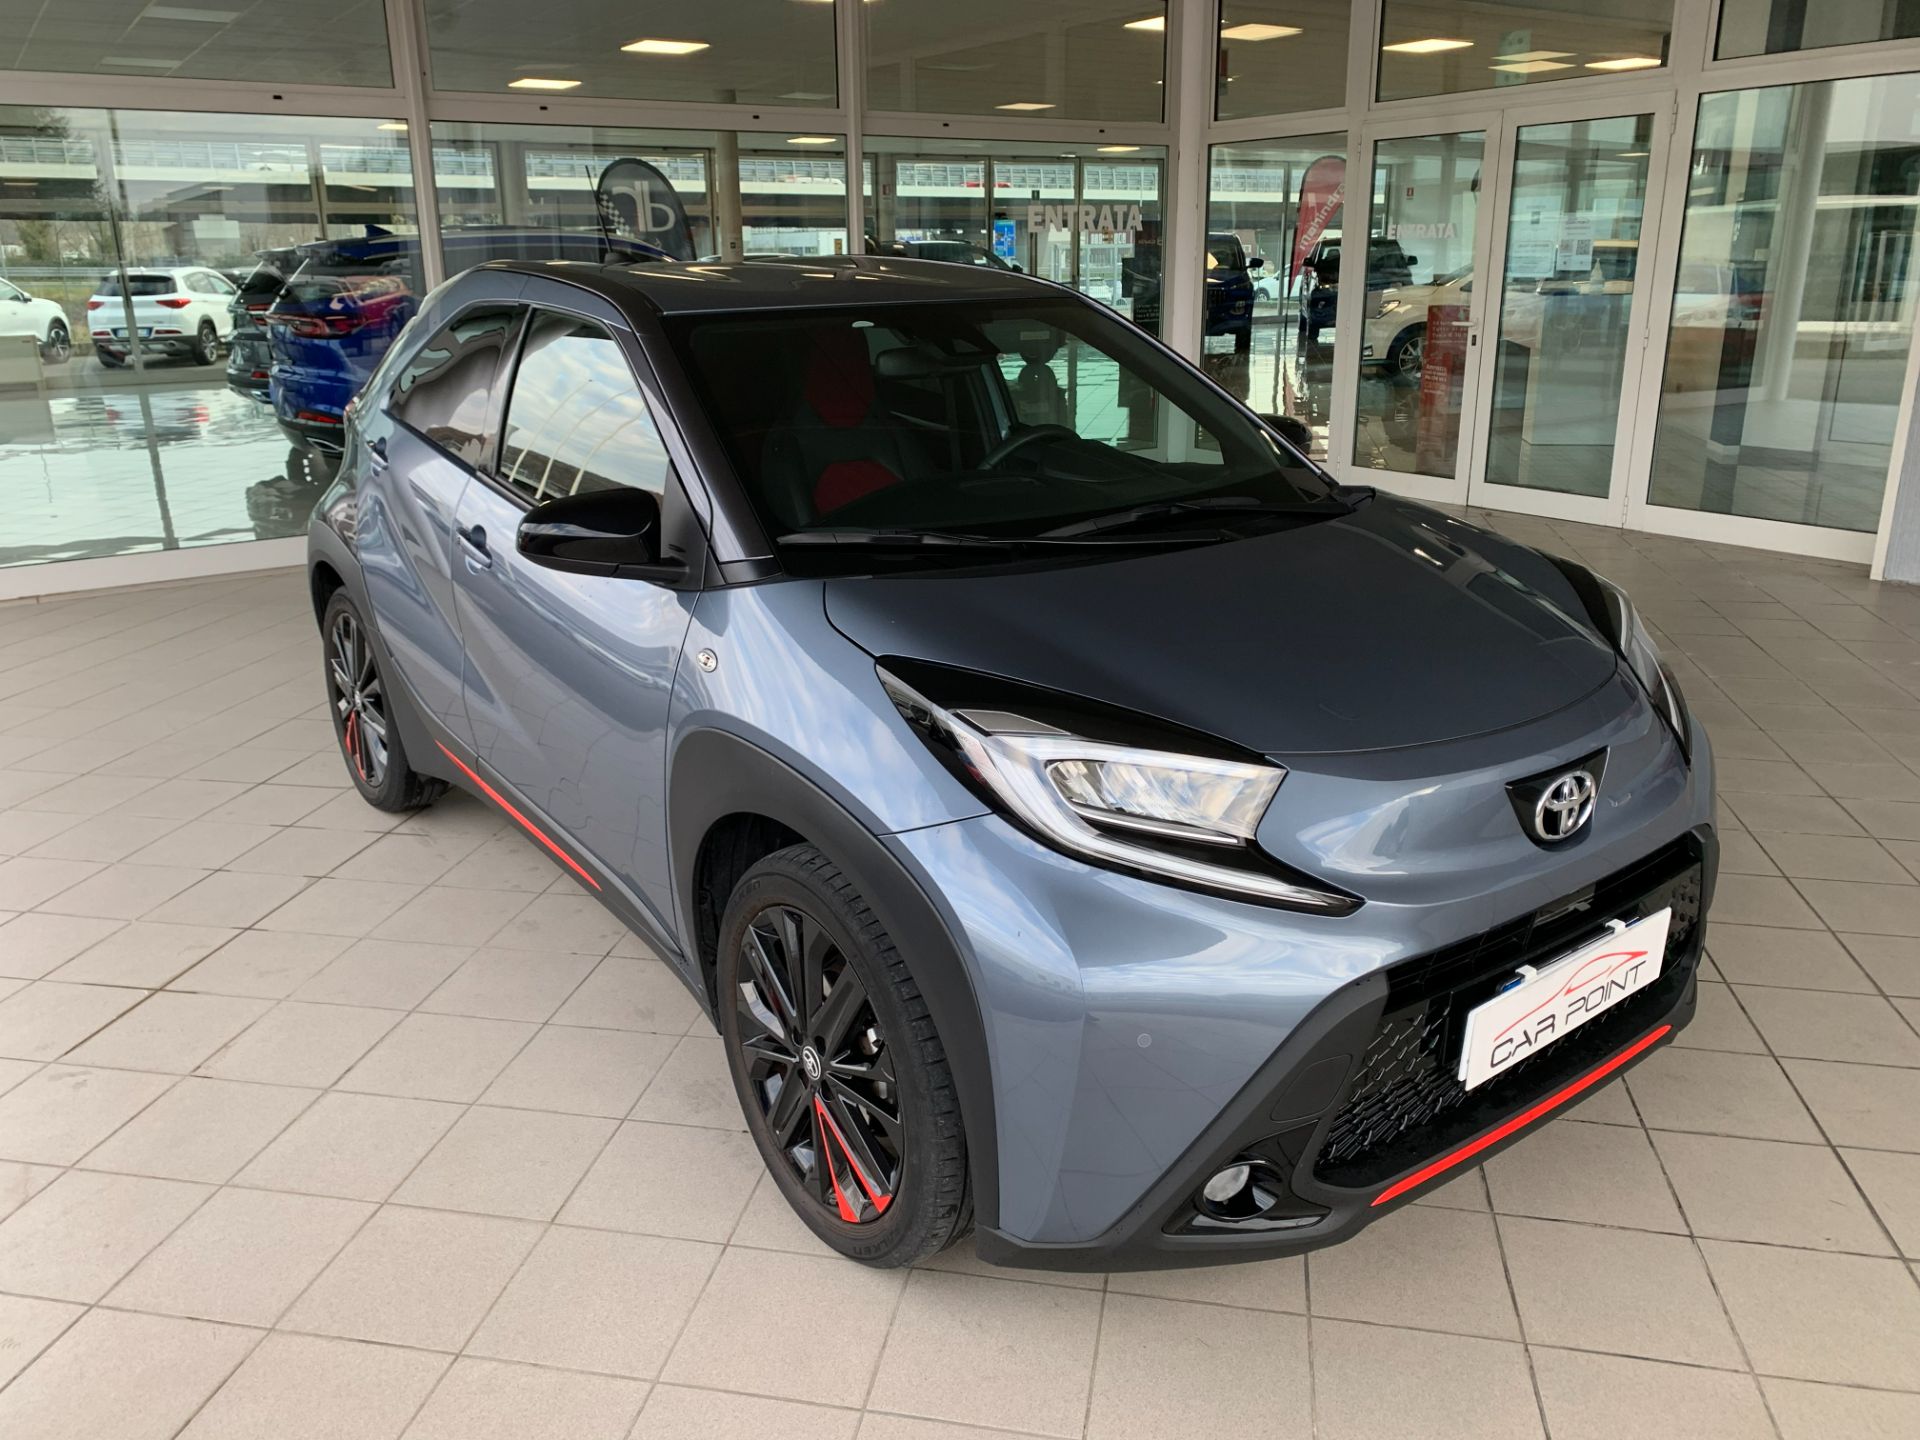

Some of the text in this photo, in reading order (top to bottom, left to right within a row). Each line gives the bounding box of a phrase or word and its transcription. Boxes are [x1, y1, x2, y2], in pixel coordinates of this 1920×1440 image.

[1028, 204, 1143, 233] ENTRATA
[1490, 960, 1647, 1068] CAR POINT
